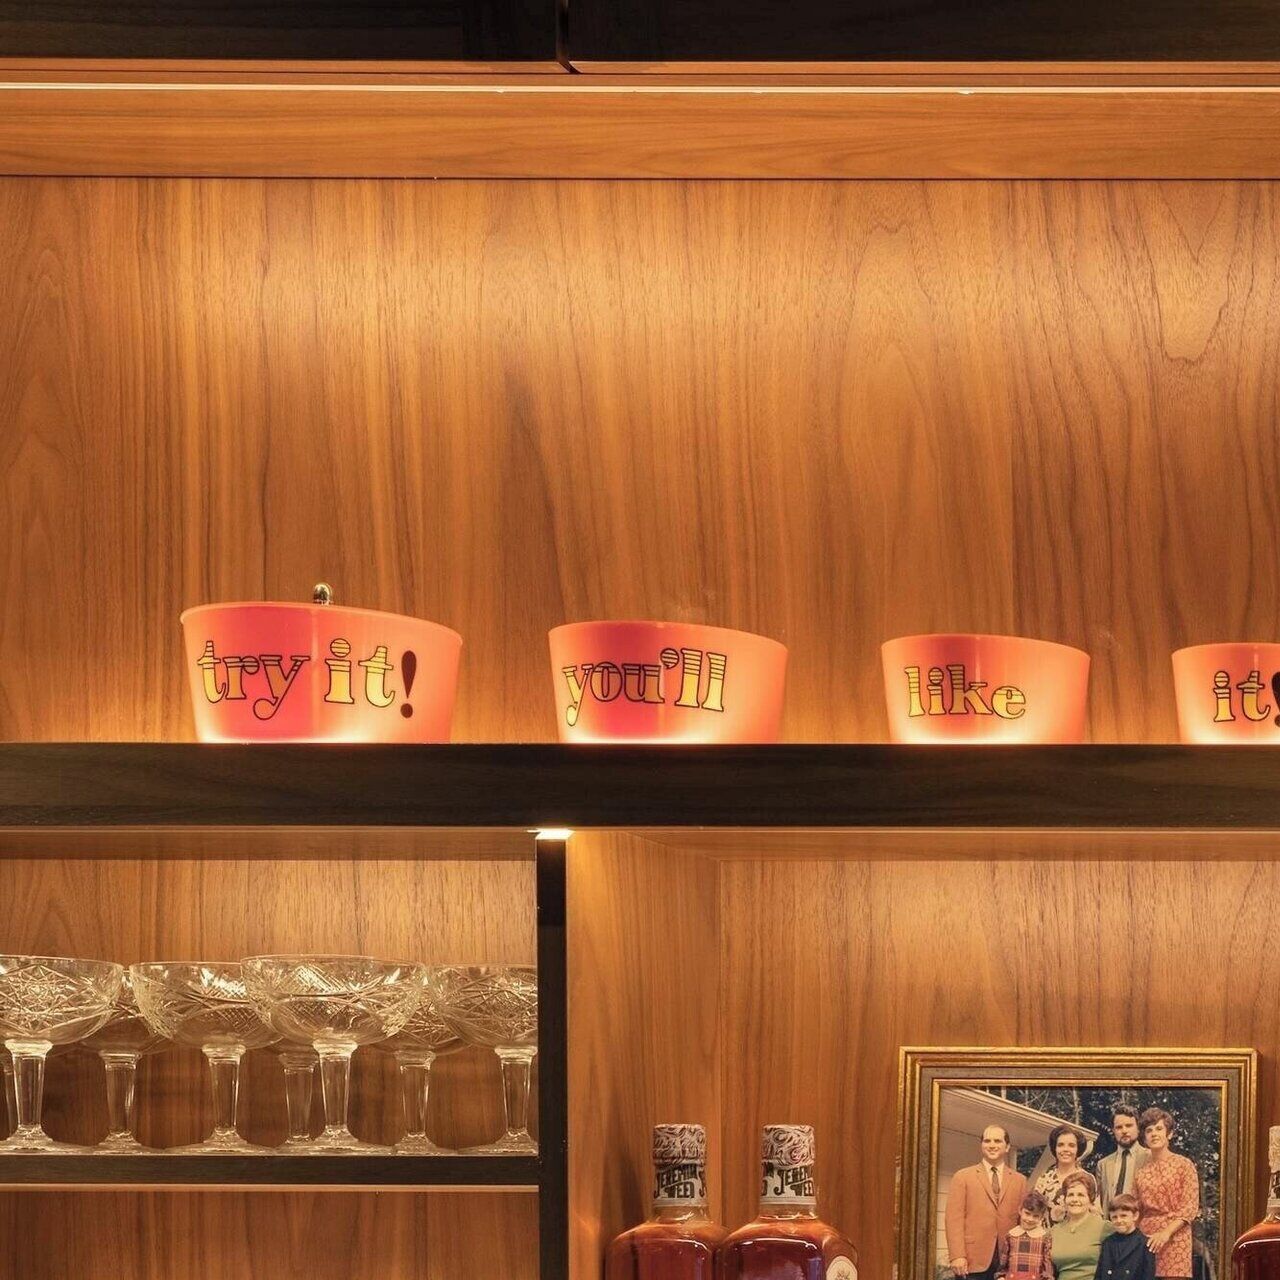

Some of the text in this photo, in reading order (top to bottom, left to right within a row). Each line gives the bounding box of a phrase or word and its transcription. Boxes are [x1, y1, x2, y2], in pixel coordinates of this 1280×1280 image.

[197, 638, 417, 720] try it!
[562, 648, 727, 726] you'll
[905, 664, 1026, 719] like
